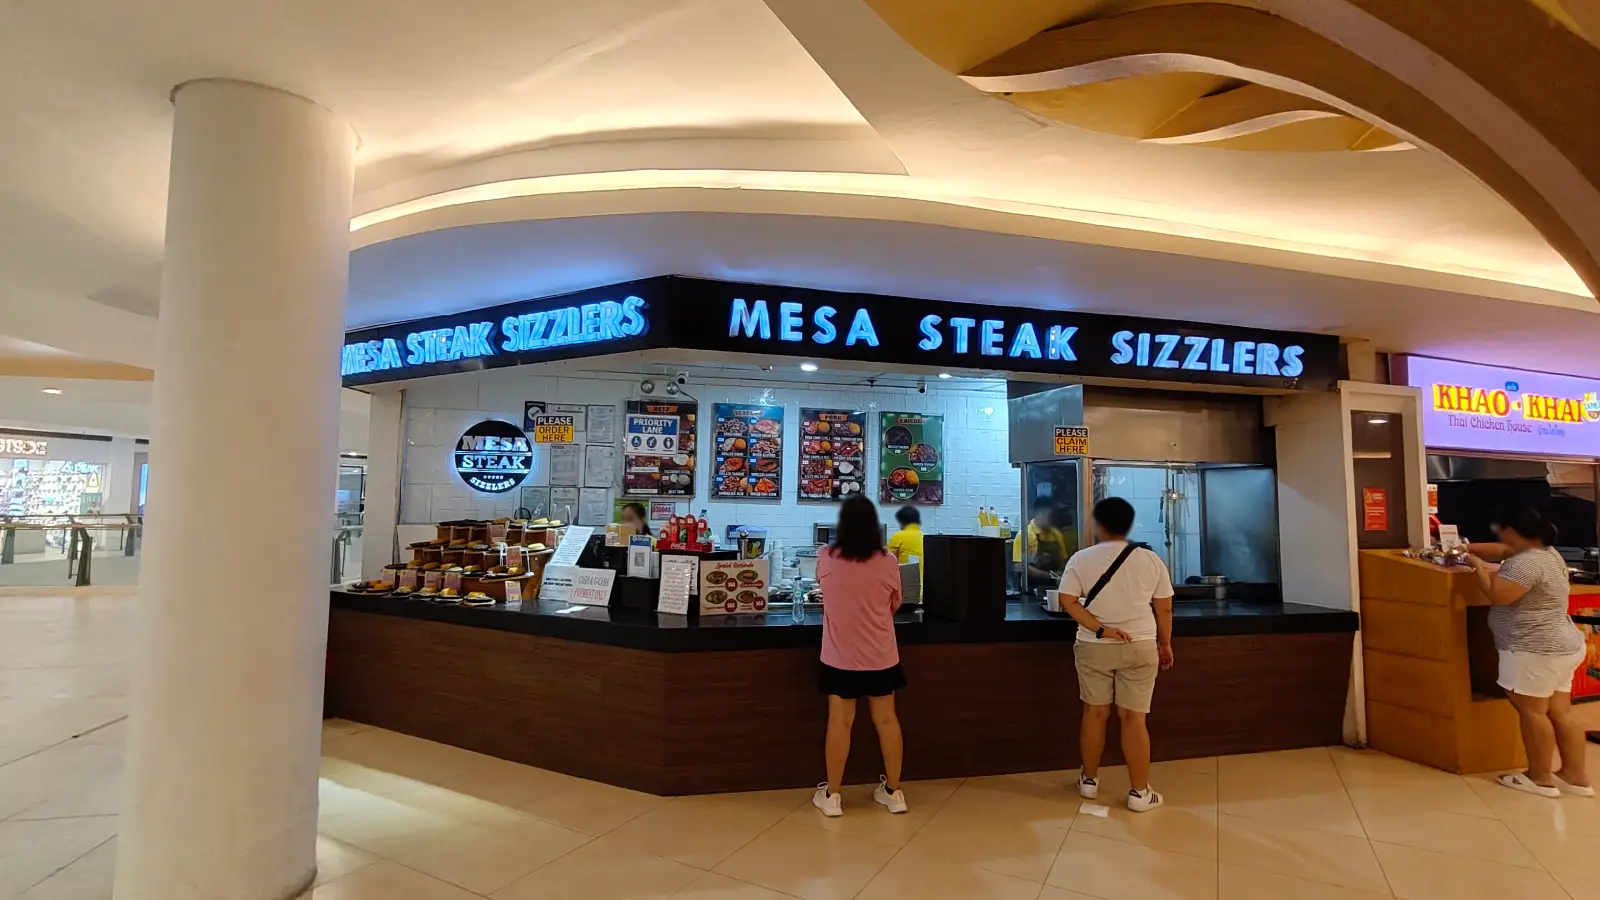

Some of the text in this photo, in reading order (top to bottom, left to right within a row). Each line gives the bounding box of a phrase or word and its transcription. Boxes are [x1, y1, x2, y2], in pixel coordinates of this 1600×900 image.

[407, 321, 495, 365] STEAK
[501, 295, 648, 352] SIZZLERS
[729, 298, 1305, 377] MESA STEAK SIZZLERS
[1432, 384, 1583, 423] KHAO KHAI
[537, 416, 573, 426] PLEASE
[632, 418, 673, 427] PRIORITY
[1448, 415, 1468, 428] Thai
[1470, 416, 1505, 431] Chicken
[538, 426, 570, 435] ORDER
[642, 425, 664, 434] LANE
[1056, 428, 1088, 437] PLEASE
[542, 433, 566, 442] HERE
[1056, 437, 1087, 446] CLAIM
[461, 435, 530, 452] MESA
[1059, 445, 1085, 453] HERE
[462, 455, 526, 470] STEAK
[469, 476, 516, 492] SIZZLERS
